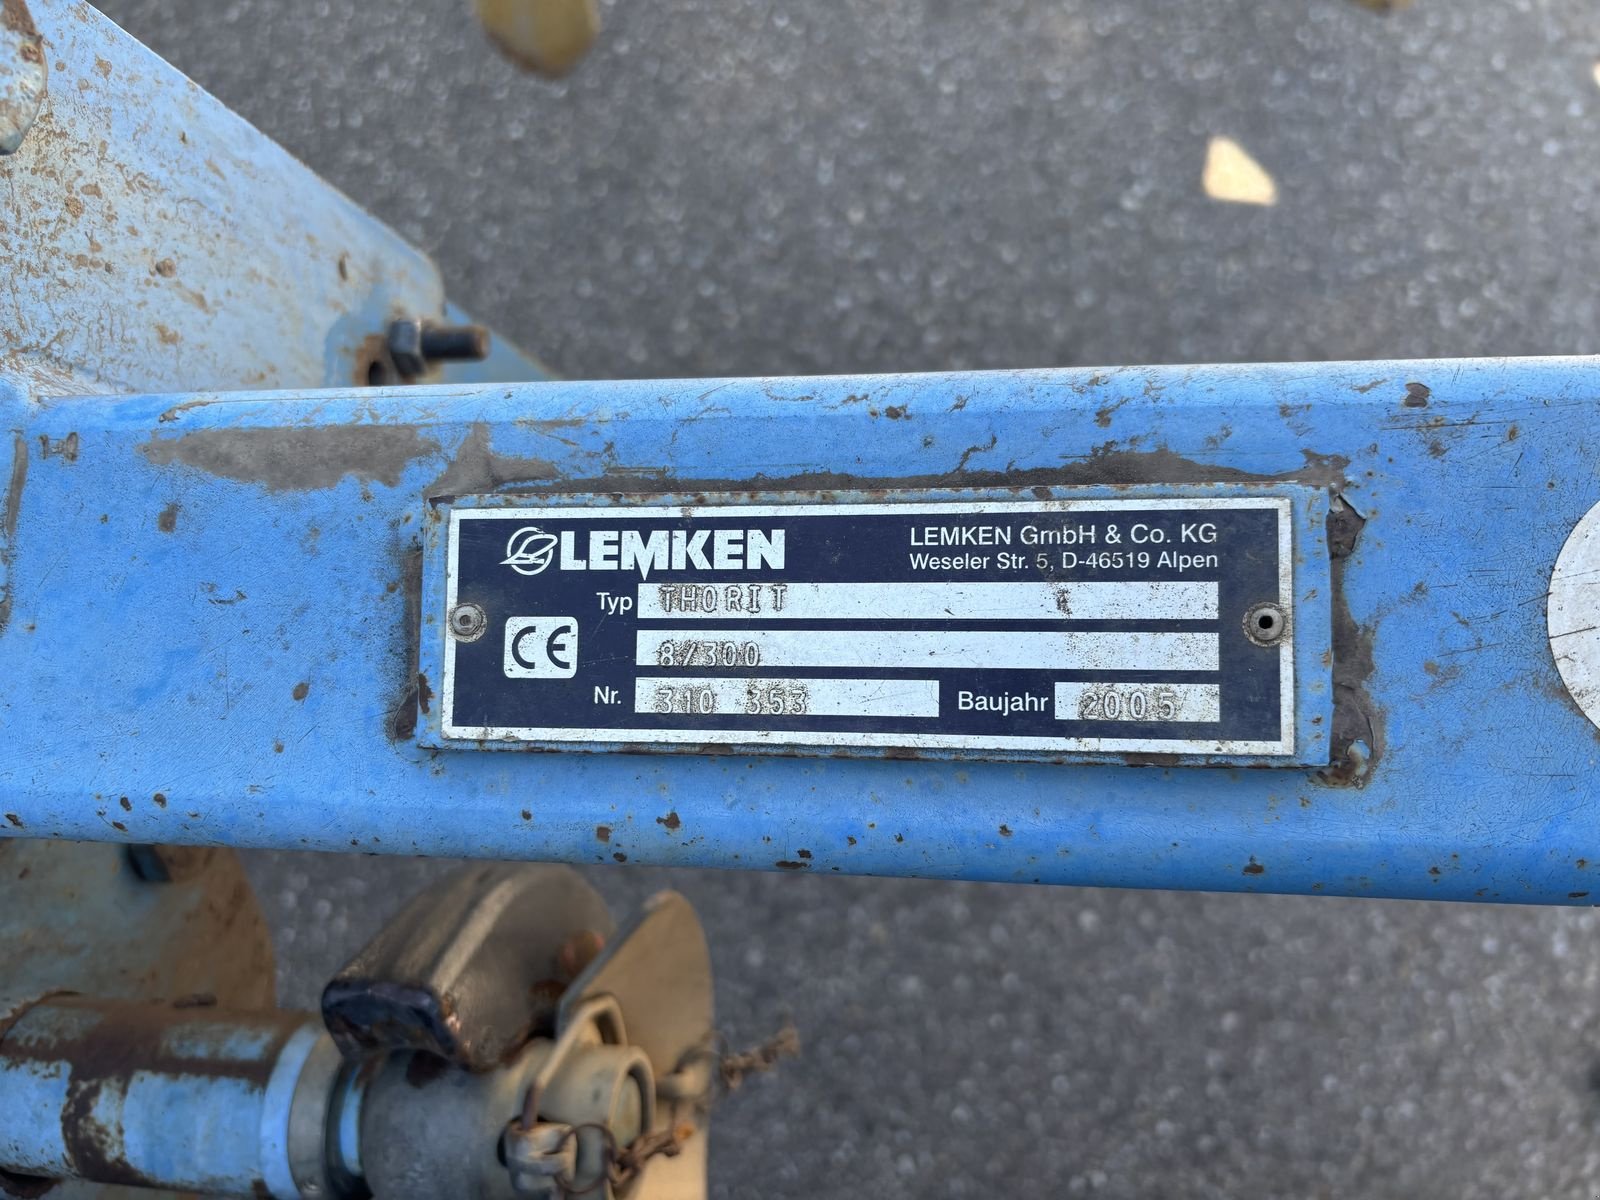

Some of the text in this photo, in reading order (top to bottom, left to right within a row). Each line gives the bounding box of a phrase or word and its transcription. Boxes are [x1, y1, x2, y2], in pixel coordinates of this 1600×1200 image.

[910, 523, 1217, 546] LEMKEN GmbH & Co. KG
[560, 529, 785, 581] LEMKEN
[909, 551, 1218, 573] Weseler Str. 5, D-46519 Alpen
[596, 584, 788, 615] Typ THORIT
[511, 625, 571, 669] CE
[659, 641, 760, 667] 8/300
[594, 686, 807, 715] Nr. 310 353
[958, 691, 1178, 720] Baujahr 2005
